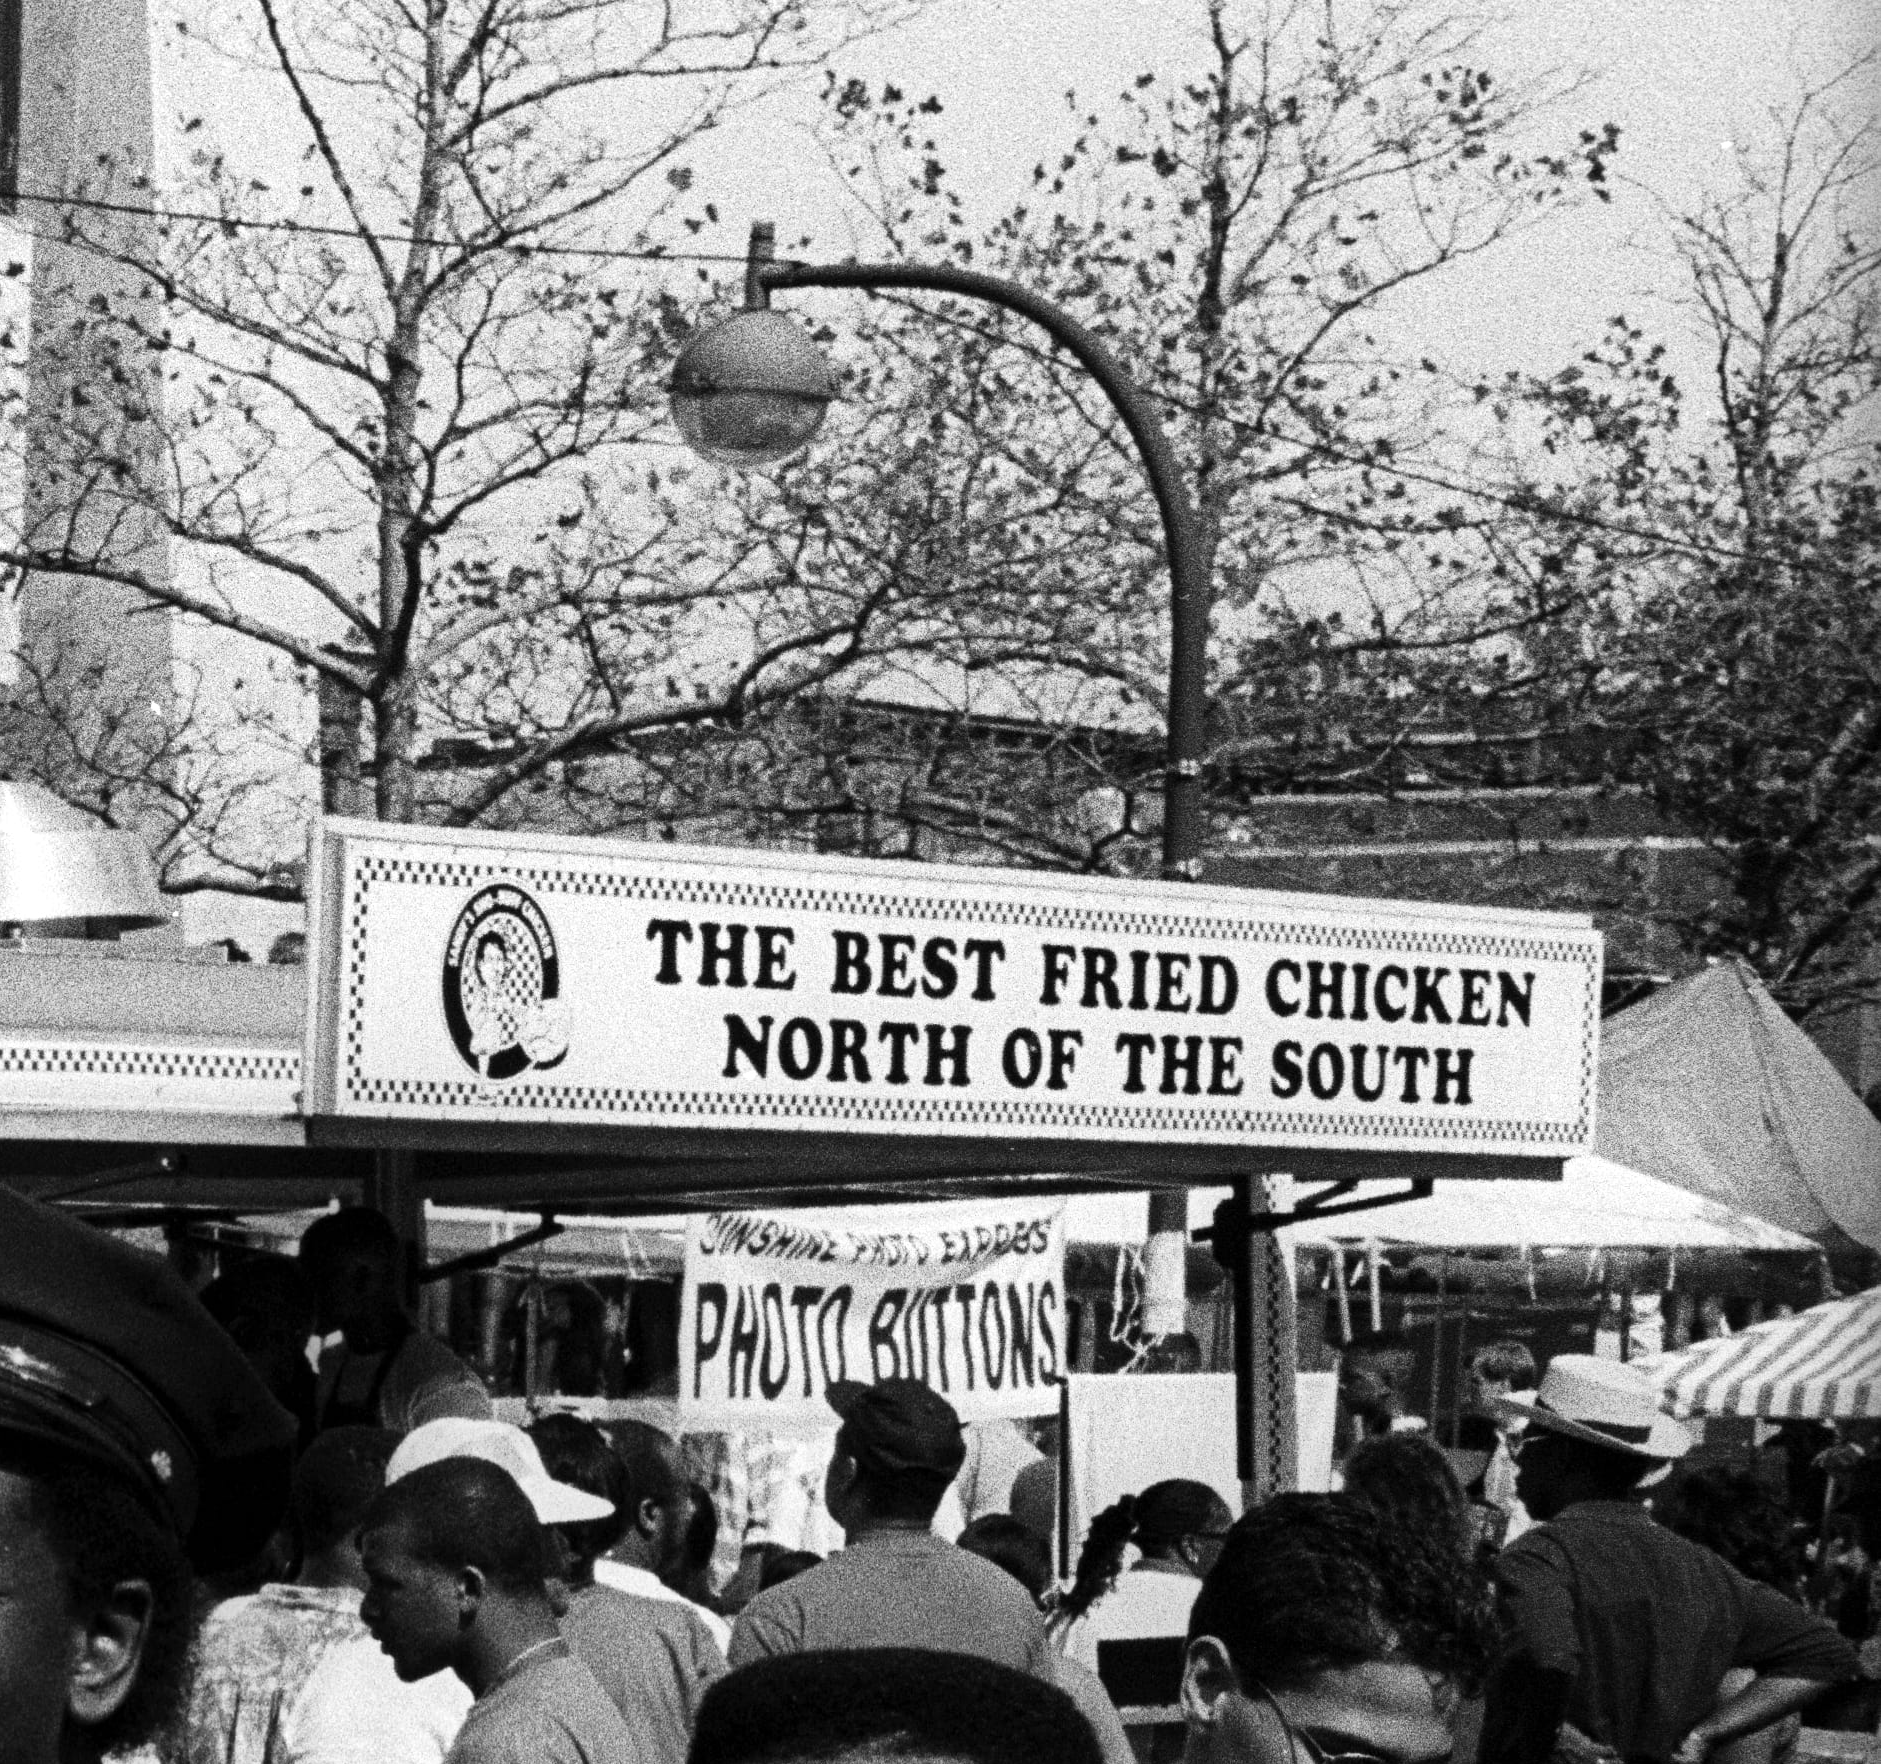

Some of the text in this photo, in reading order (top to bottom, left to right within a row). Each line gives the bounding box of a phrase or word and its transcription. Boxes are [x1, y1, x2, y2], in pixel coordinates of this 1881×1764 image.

[646, 917, 1536, 1030] THE BEST FRIED CHICKEN
[722, 1013, 1475, 1106] NORTH OF THE SOUTH
[694, 1279, 1066, 1401] PHOTO BUTTONS
